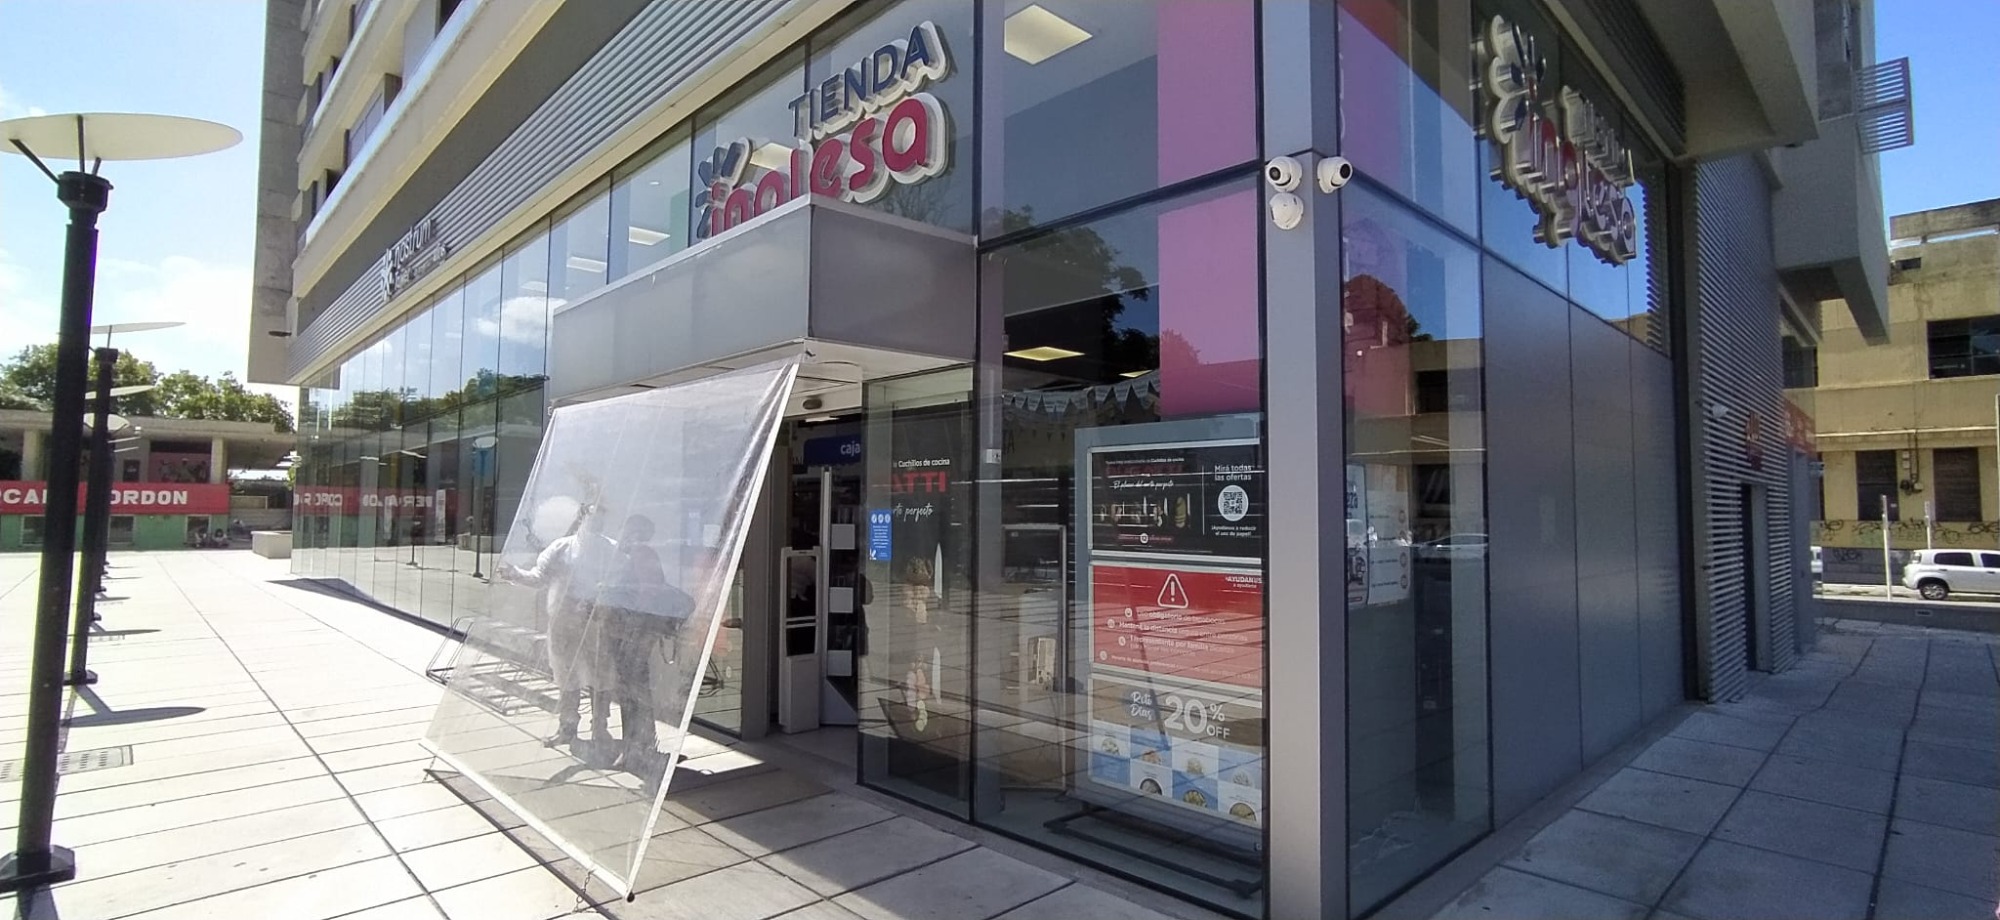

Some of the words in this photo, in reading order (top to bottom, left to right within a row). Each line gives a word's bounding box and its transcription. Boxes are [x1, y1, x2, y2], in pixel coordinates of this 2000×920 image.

[788, 25, 930, 138] TIENDA
[840, 440, 861, 457] caja
[898, 459, 922, 468] Cuchillos
[931, 458, 951, 466] cocina
[1231, 464, 1252, 472] todas
[1226, 473, 1252, 481] ofertas
[109, 490, 188, 505] ORDON
[1206, 725, 1231, 739] OFF
